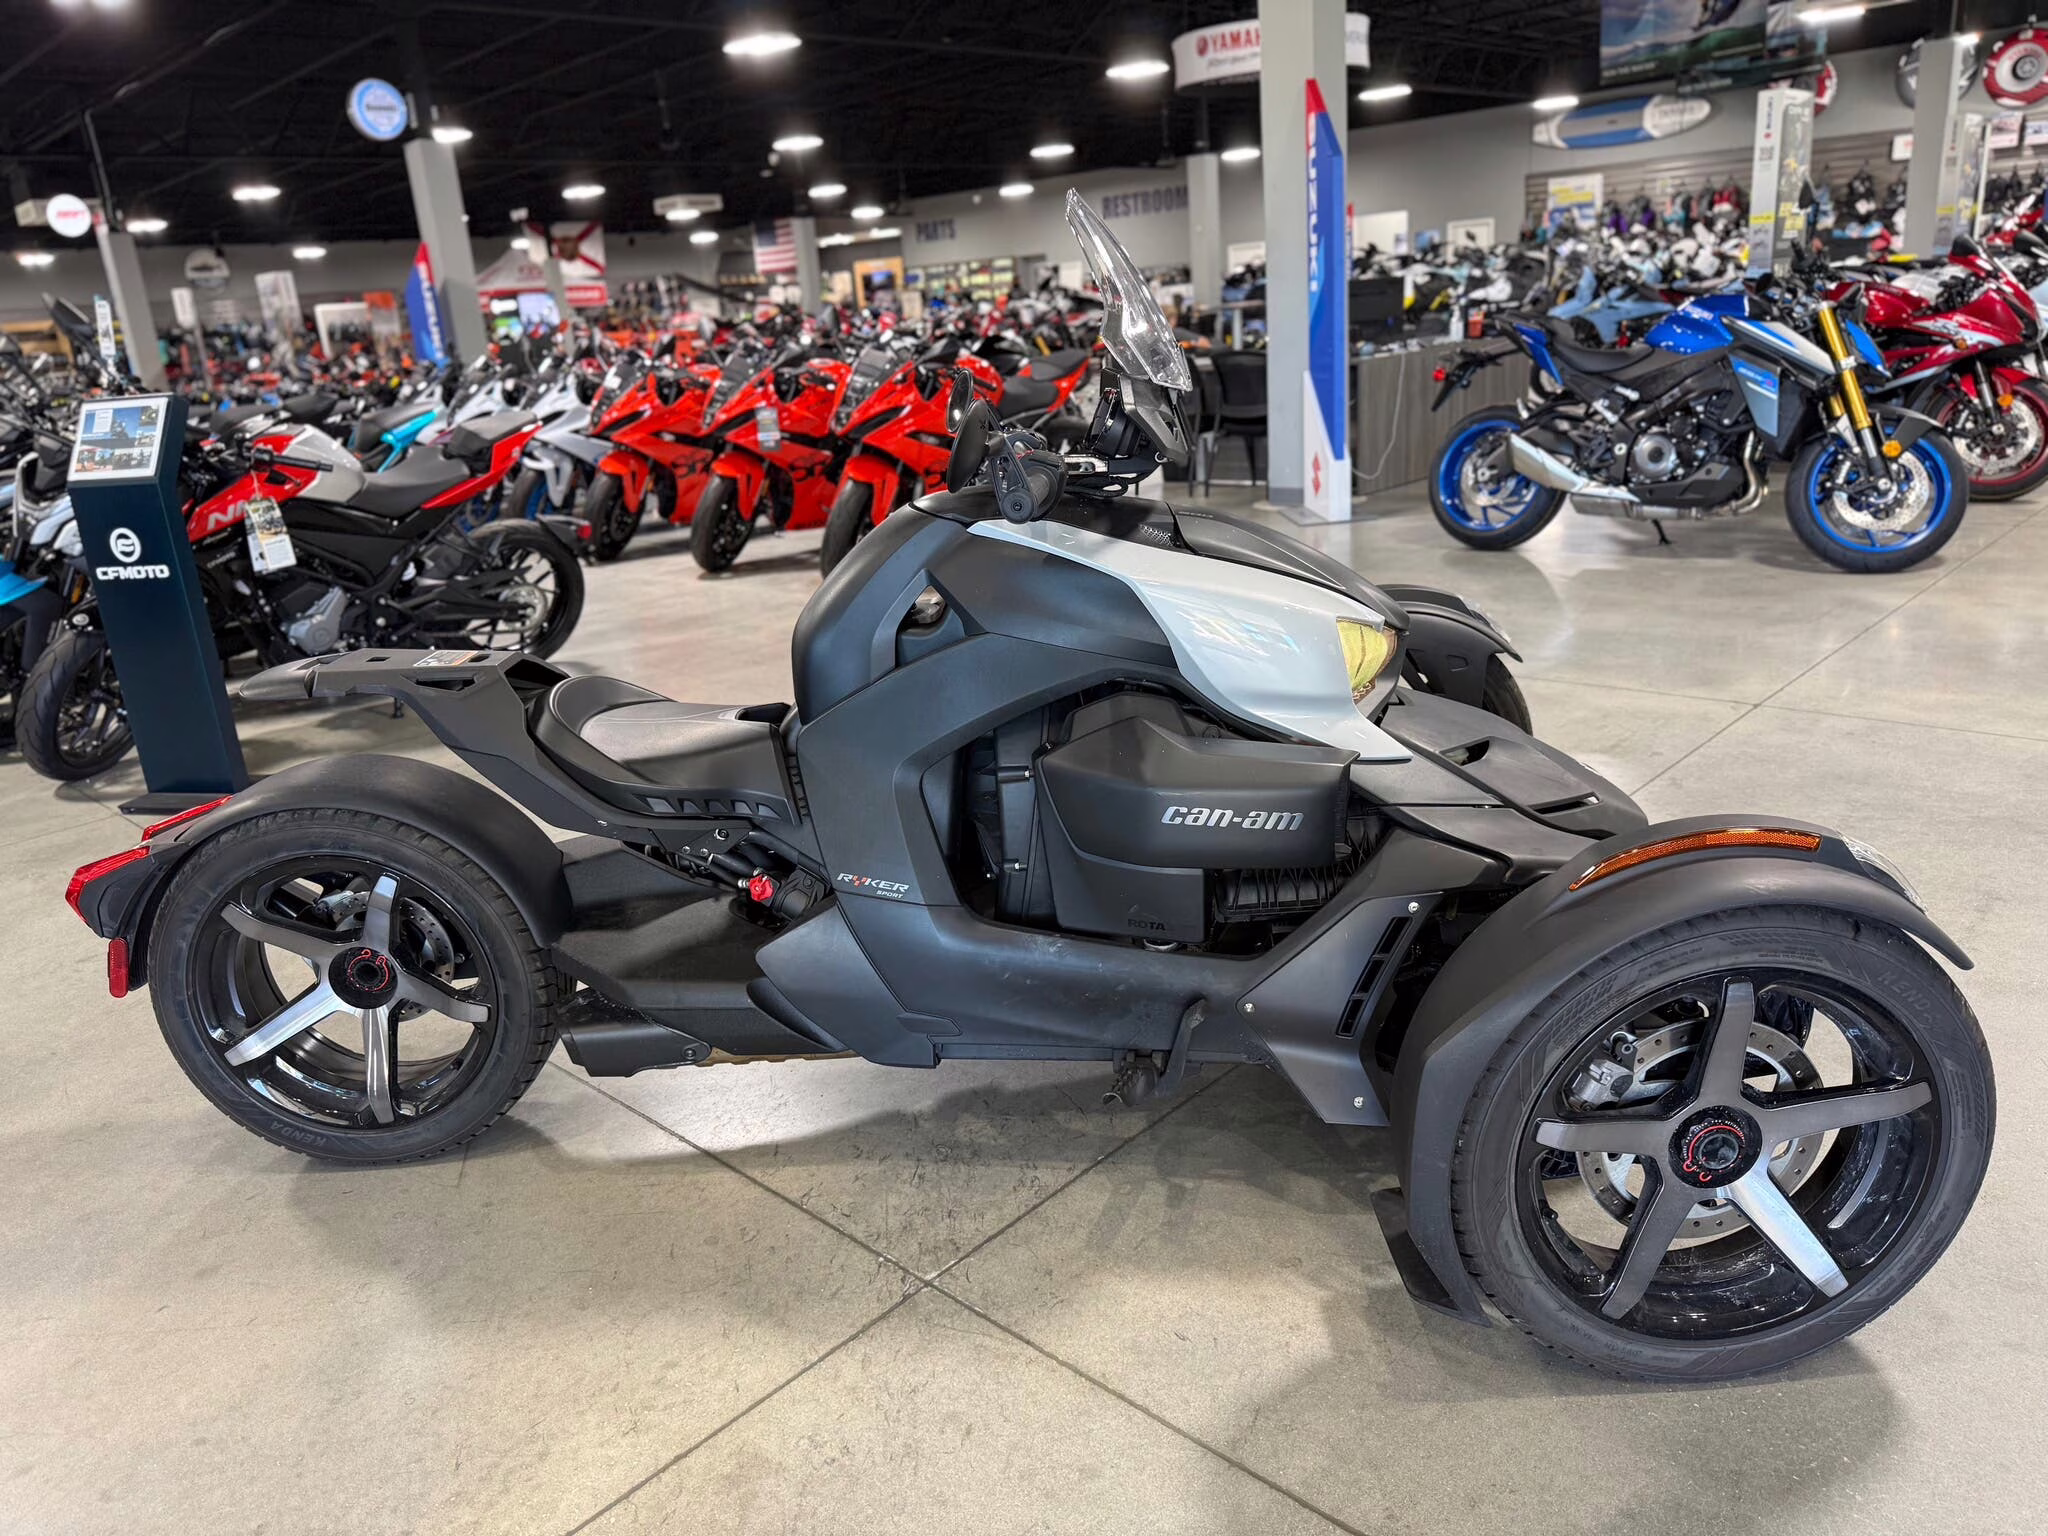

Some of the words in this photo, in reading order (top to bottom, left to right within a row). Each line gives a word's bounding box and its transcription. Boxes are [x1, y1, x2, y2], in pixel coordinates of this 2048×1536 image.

[1308, 111, 1319, 293] SUZUKI
[915, 218, 957, 243] PARTS
[96, 564, 170, 581] CFMOTO
[1160, 806, 1304, 831] can-am
[837, 872, 910, 893] RYKER
[876, 889, 904, 899] SPORT
[270, 1120, 327, 1147] KENDA
